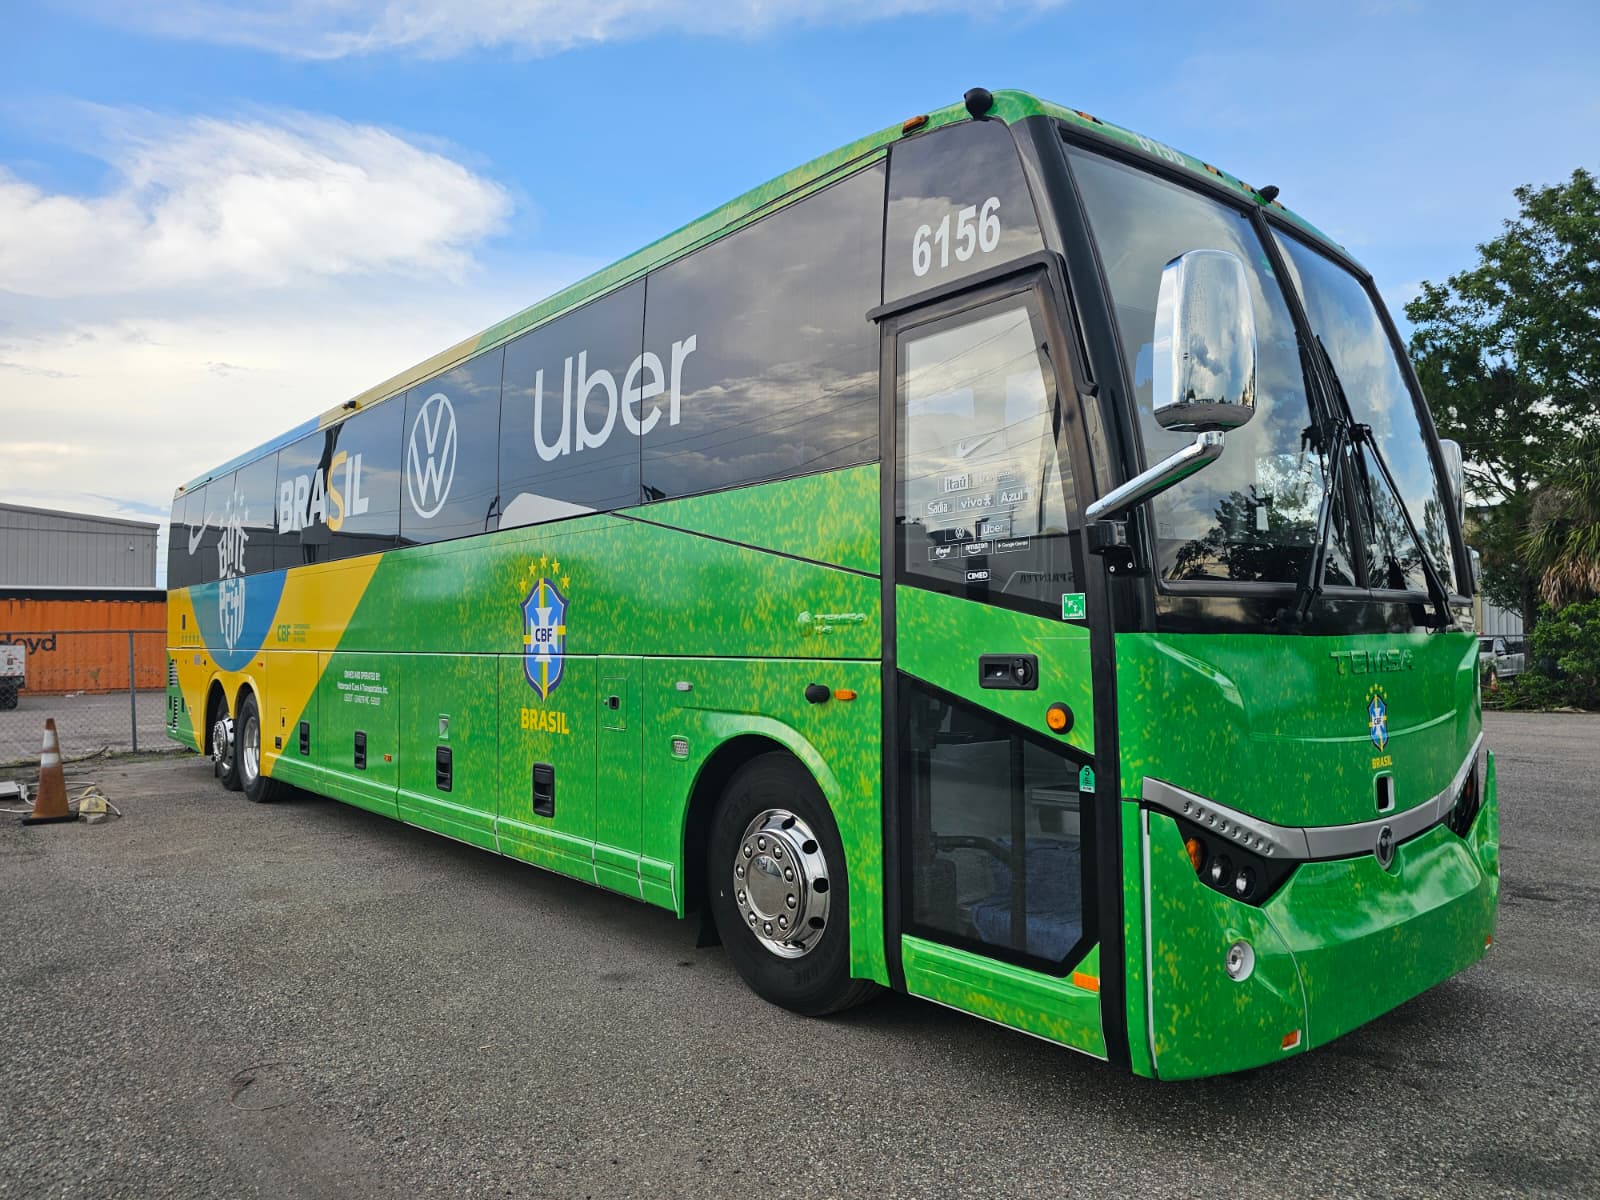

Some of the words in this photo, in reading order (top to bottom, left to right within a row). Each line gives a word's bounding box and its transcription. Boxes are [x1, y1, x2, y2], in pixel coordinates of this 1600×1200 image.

[911, 196, 1001, 277] 6156
[533, 334, 697, 462] Uber
[279, 449, 369, 536] BRASIL
[1000, 490, 1024, 503] Azul
[960, 497, 983, 509] vivo
[967, 571, 989, 581] CIMED
[277, 624, 292, 642] CBF
[535, 628, 553, 643] CBF
[520, 707, 570, 735] BRASIL
[1371, 755, 1392, 769] BRASIL
